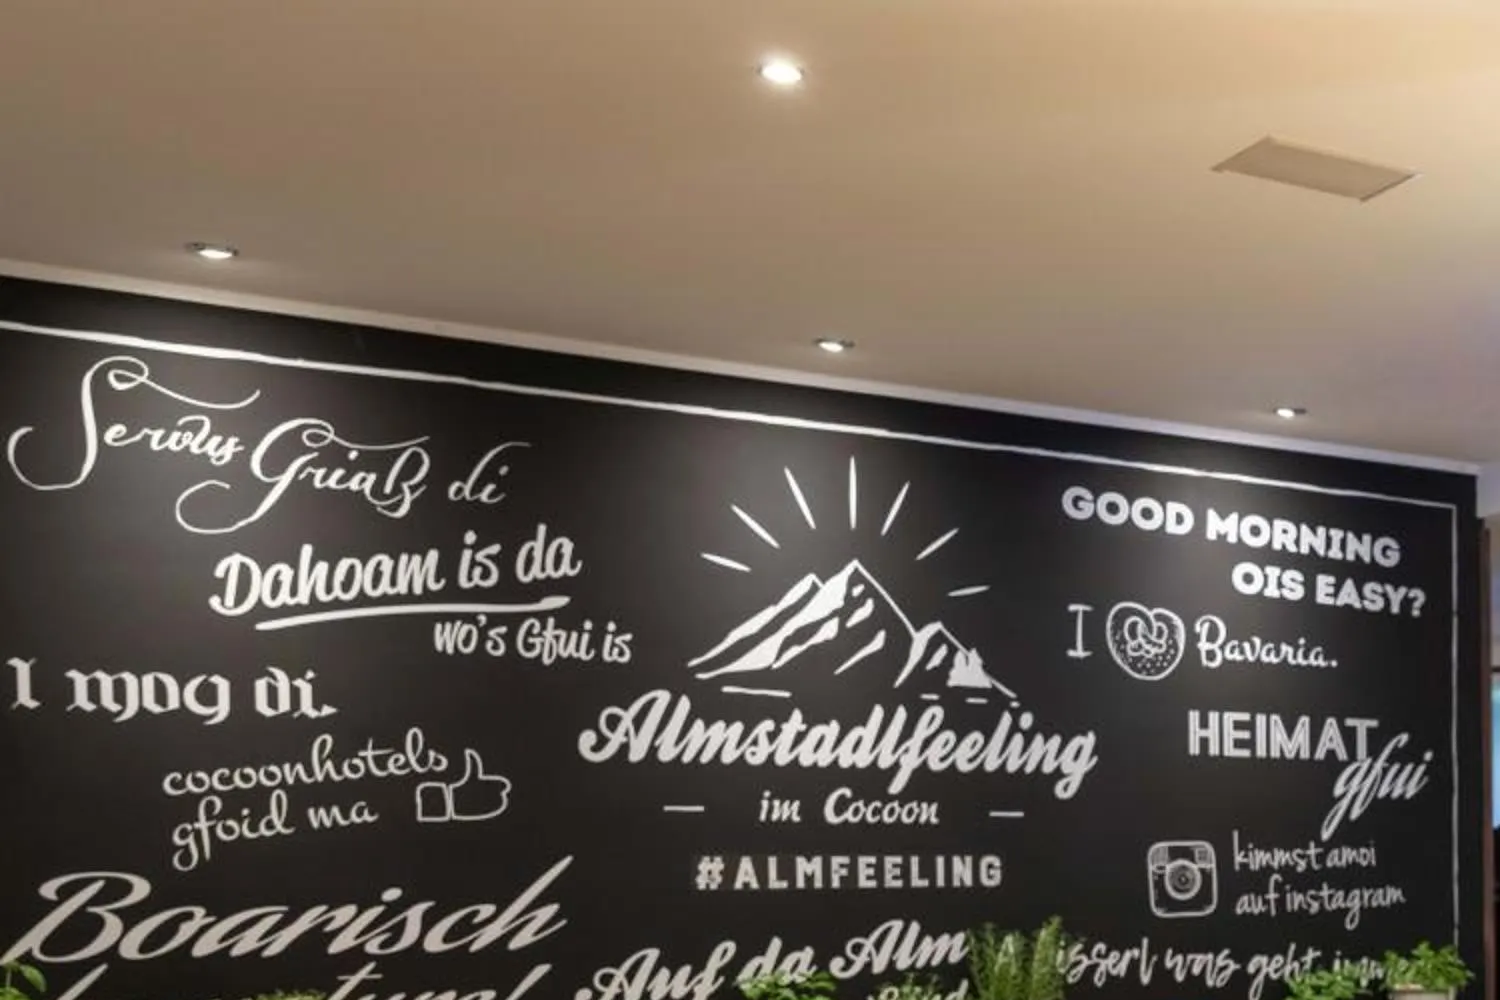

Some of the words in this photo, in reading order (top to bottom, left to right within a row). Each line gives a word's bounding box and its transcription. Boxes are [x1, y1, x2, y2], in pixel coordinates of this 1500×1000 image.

[8, 355, 261, 490] Servus
[447, 442, 533, 504] di
[1061, 486, 1194, 535] GOOD
[1206, 508, 1401, 568] MORNING
[208, 543, 446, 616] Dahoam
[458, 530, 500, 589] is
[515, 523, 583, 582] da
[1231, 562, 1304, 600] OIS
[1315, 574, 1426, 617] EASY?
[516, 616, 595, 666] Gfui
[603, 621, 633, 663] is
[1067, 603, 1093, 658] I
[1194, 615, 1338, 668] Bavaria.
[6, 656, 41, 709] I
[65, 668, 231, 724] mog
[162, 727, 448, 796] cocoonhotels
[578, 689, 1098, 799] Almstadlfeeling
[1188, 710, 1379, 761] HEIMAT
[758, 790, 802, 823] im
[823, 787, 940, 824] Cocoon
[1320, 732, 1434, 842] gfui
[172, 789, 294, 871] gfoid
[308, 800, 378, 830] ma
[1233, 830, 1322, 873] kimmst
[1326, 840, 1377, 868] amoi
[695, 854, 1002, 890] #ALMFEELING
[1235, 876, 1283, 917] auf
[1284, 884, 1406, 930] instagram
[0, 855, 574, 963] Boarisch
[735, 936, 817, 984] da
[829, 919, 969, 979] Alm
[1055, 937, 1158, 987] isserl
[1165, 948, 1241, 988] was
